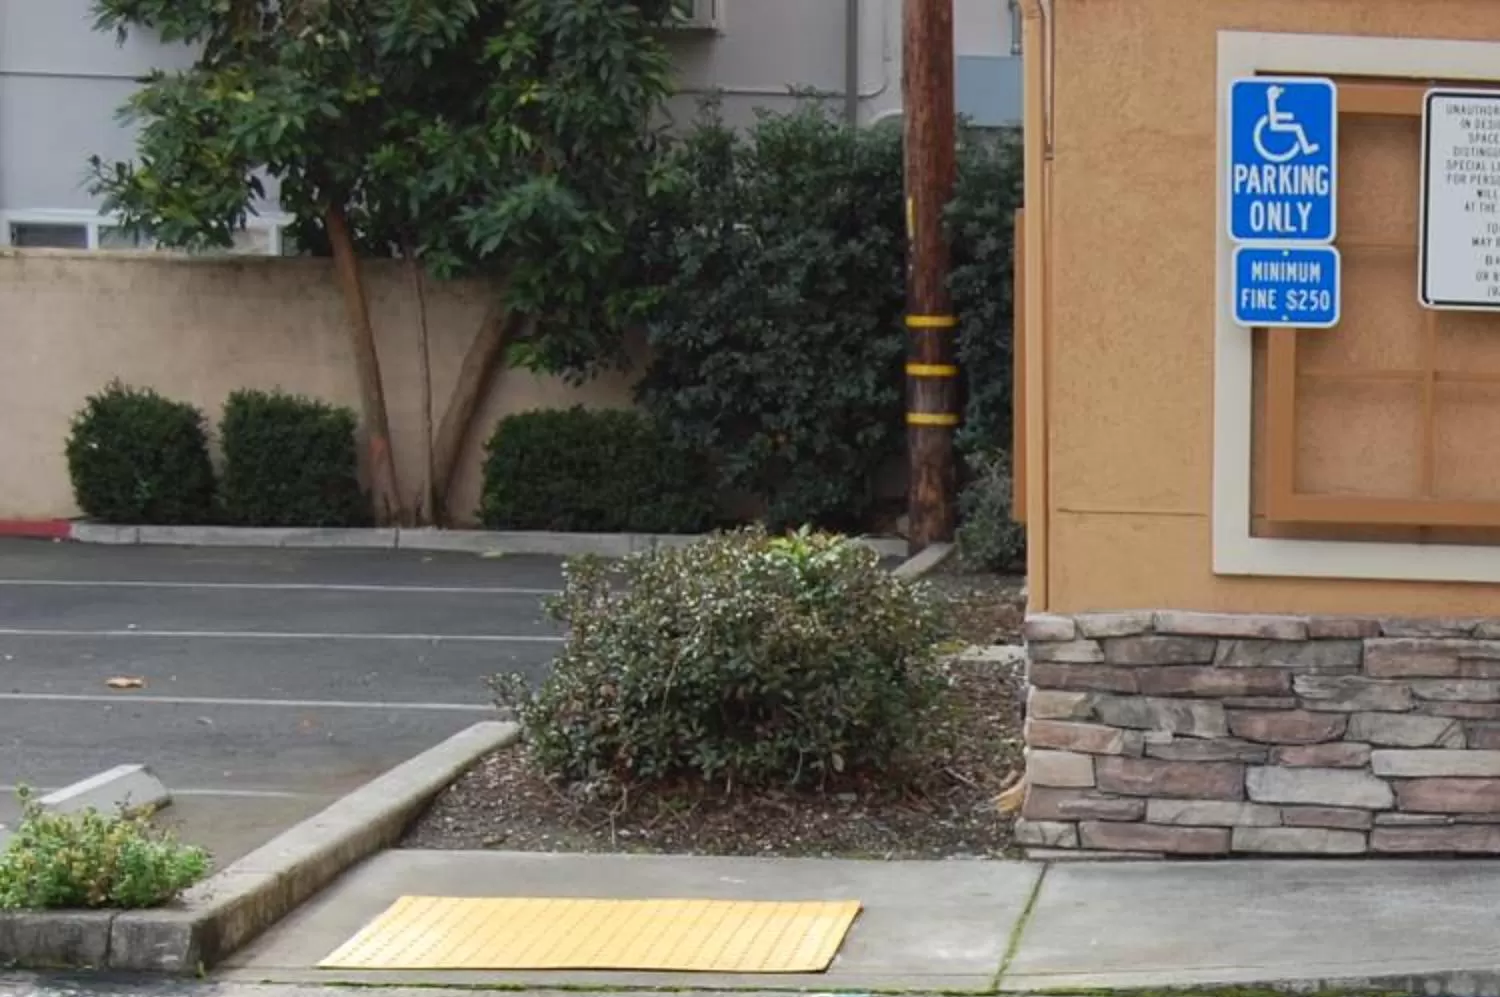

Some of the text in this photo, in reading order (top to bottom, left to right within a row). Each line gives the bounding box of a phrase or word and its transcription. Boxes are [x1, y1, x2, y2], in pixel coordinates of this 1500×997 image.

[1460, 119, 1471, 129] IN
[1446, 159, 1486, 171] SPECIAL
[1234, 163, 1329, 196] PARKING
[1447, 173, 1467, 185] FOR
[1477, 189, 1497, 200] WILL
[1464, 201, 1475, 212] AT
[1479, 202, 1496, 213] THE
[1250, 201, 1312, 232] ONLY
[1472, 236, 1492, 247] MAY
[1251, 261, 1321, 283] MINIMUM
[1475, 271, 1489, 283] OR
[1241, 288, 1330, 311] FINE $250
